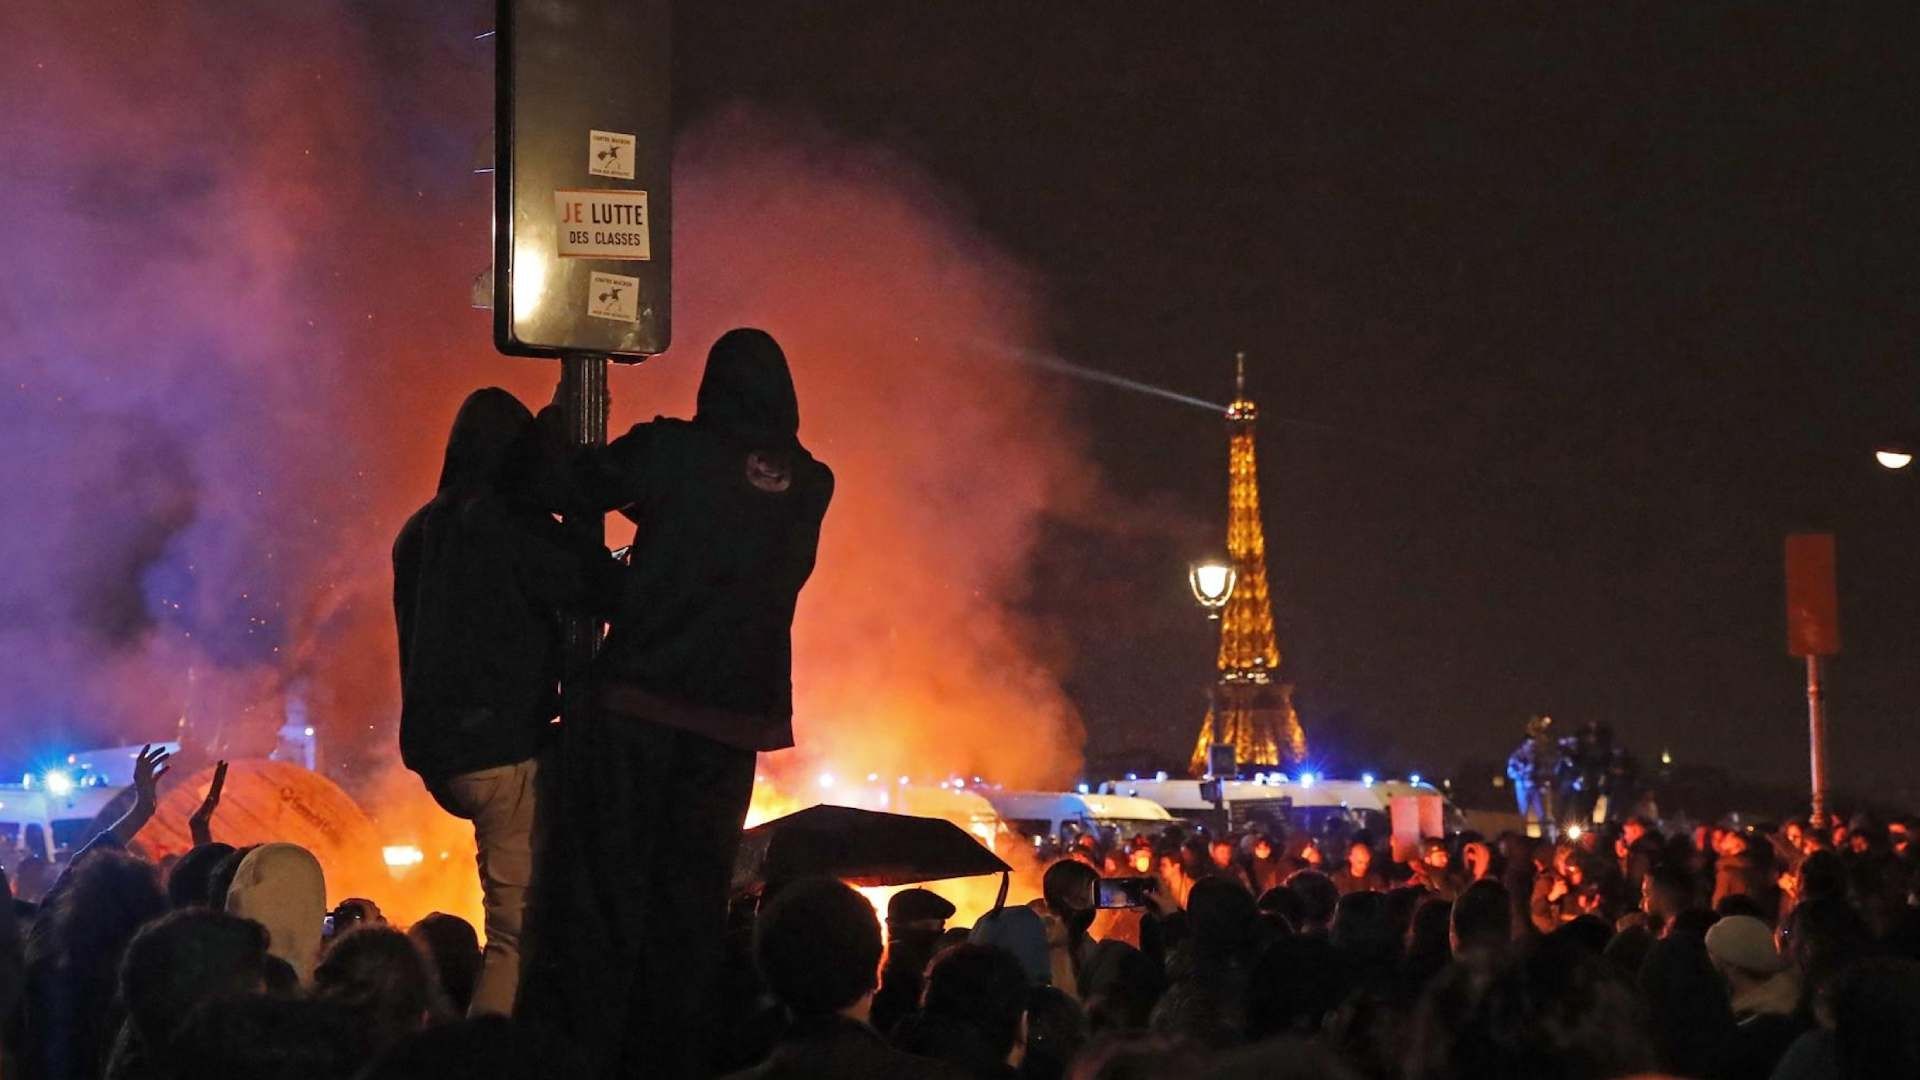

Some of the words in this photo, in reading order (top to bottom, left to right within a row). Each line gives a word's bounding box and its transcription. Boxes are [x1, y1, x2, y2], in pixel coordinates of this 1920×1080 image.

[562, 202, 583, 224] JE
[591, 203, 644, 225] LUTTE
[569, 231, 589, 244] DES
[595, 232, 641, 246] CLASSES
